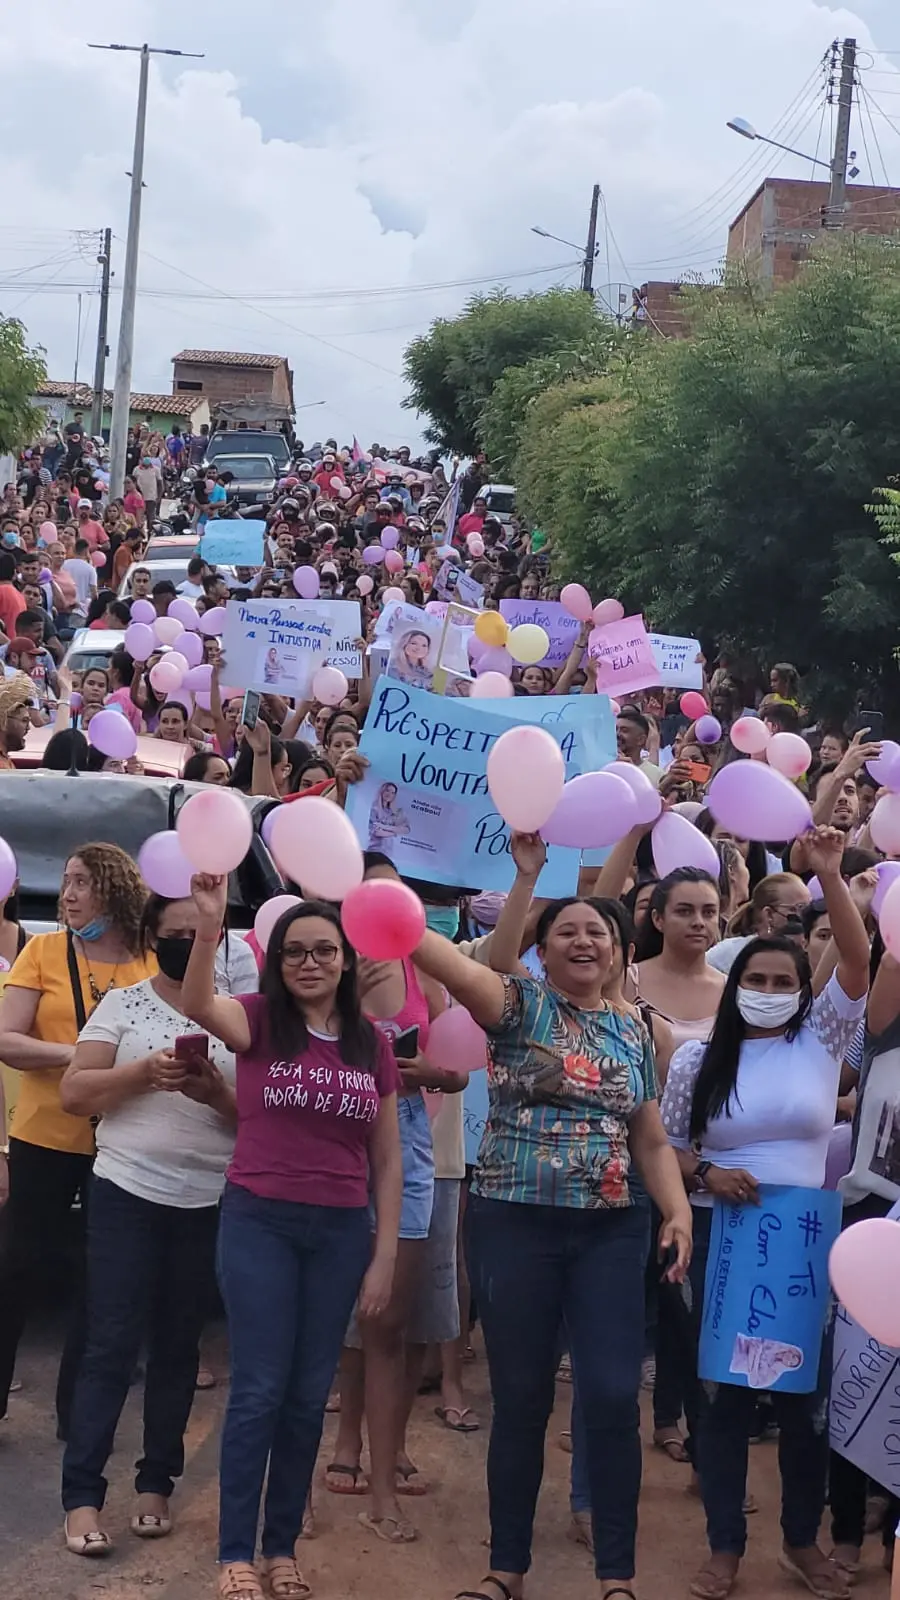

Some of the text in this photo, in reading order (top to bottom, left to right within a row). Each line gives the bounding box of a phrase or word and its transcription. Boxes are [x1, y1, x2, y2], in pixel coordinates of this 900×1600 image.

[239, 607, 268, 625] Nova
[306, 621, 333, 637] contra
[245, 629, 322, 652] a INJUSTIÇA
[612, 649, 640, 671] ELA!
[662, 661, 684, 672] ELA!
[372, 687, 500, 753] RESPEIT
[560, 731, 578, 762] A
[401, 751, 489, 796] VONTA
[267, 1061, 302, 1080] SEJA
[308, 1067, 333, 1085] SEU
[263, 1083, 309, 1109] PADRÃO
[314, 1091, 335, 1113] DE
[722, 1236, 734, 1255] AO
[747, 1213, 783, 1335] Com Ela
